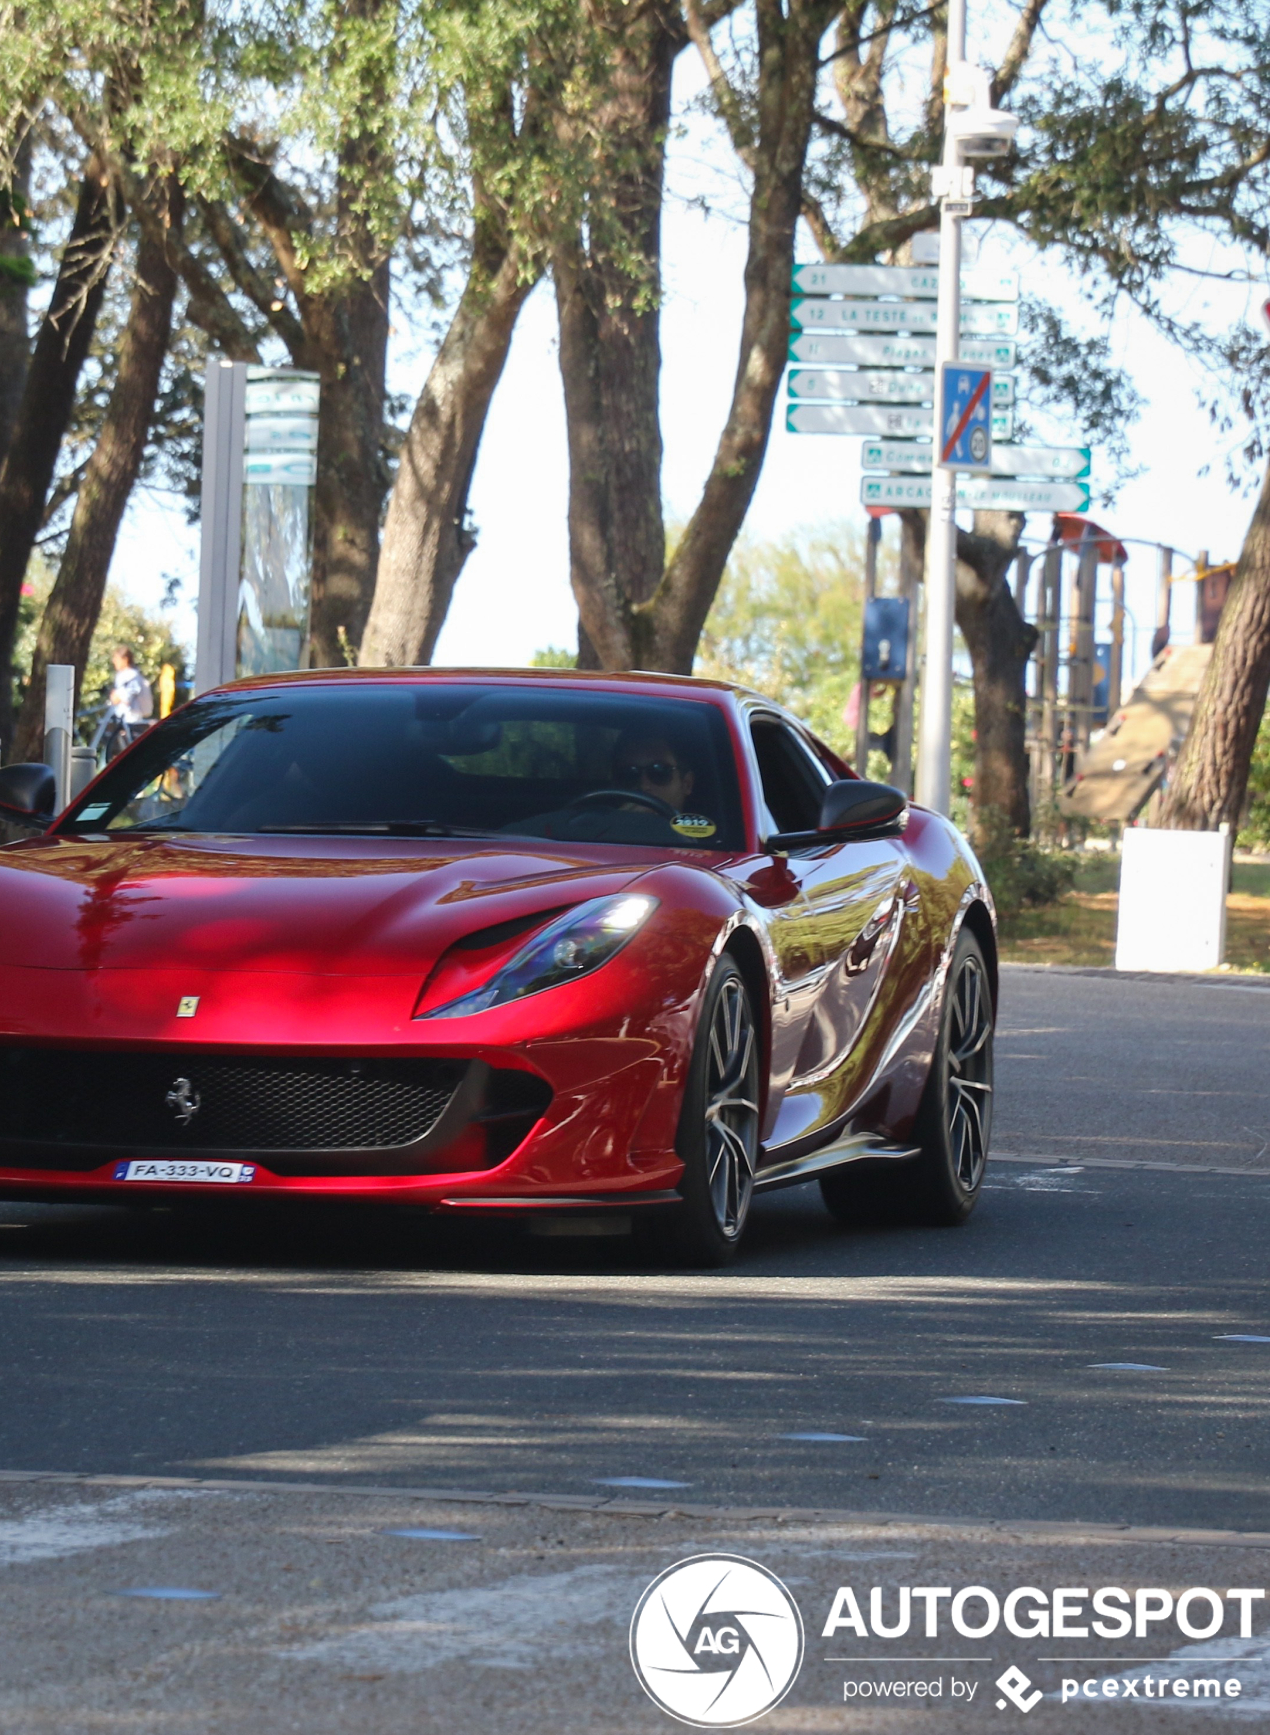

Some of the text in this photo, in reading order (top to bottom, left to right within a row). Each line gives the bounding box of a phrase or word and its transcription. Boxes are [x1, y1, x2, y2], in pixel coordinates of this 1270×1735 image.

[811, 274, 826, 285] 21
[810, 308, 825, 320] 12
[842, 310, 858, 321] LA
[865, 309, 907, 323] TESTE
[133, 1164, 234, 1179] FA-333-VQ
